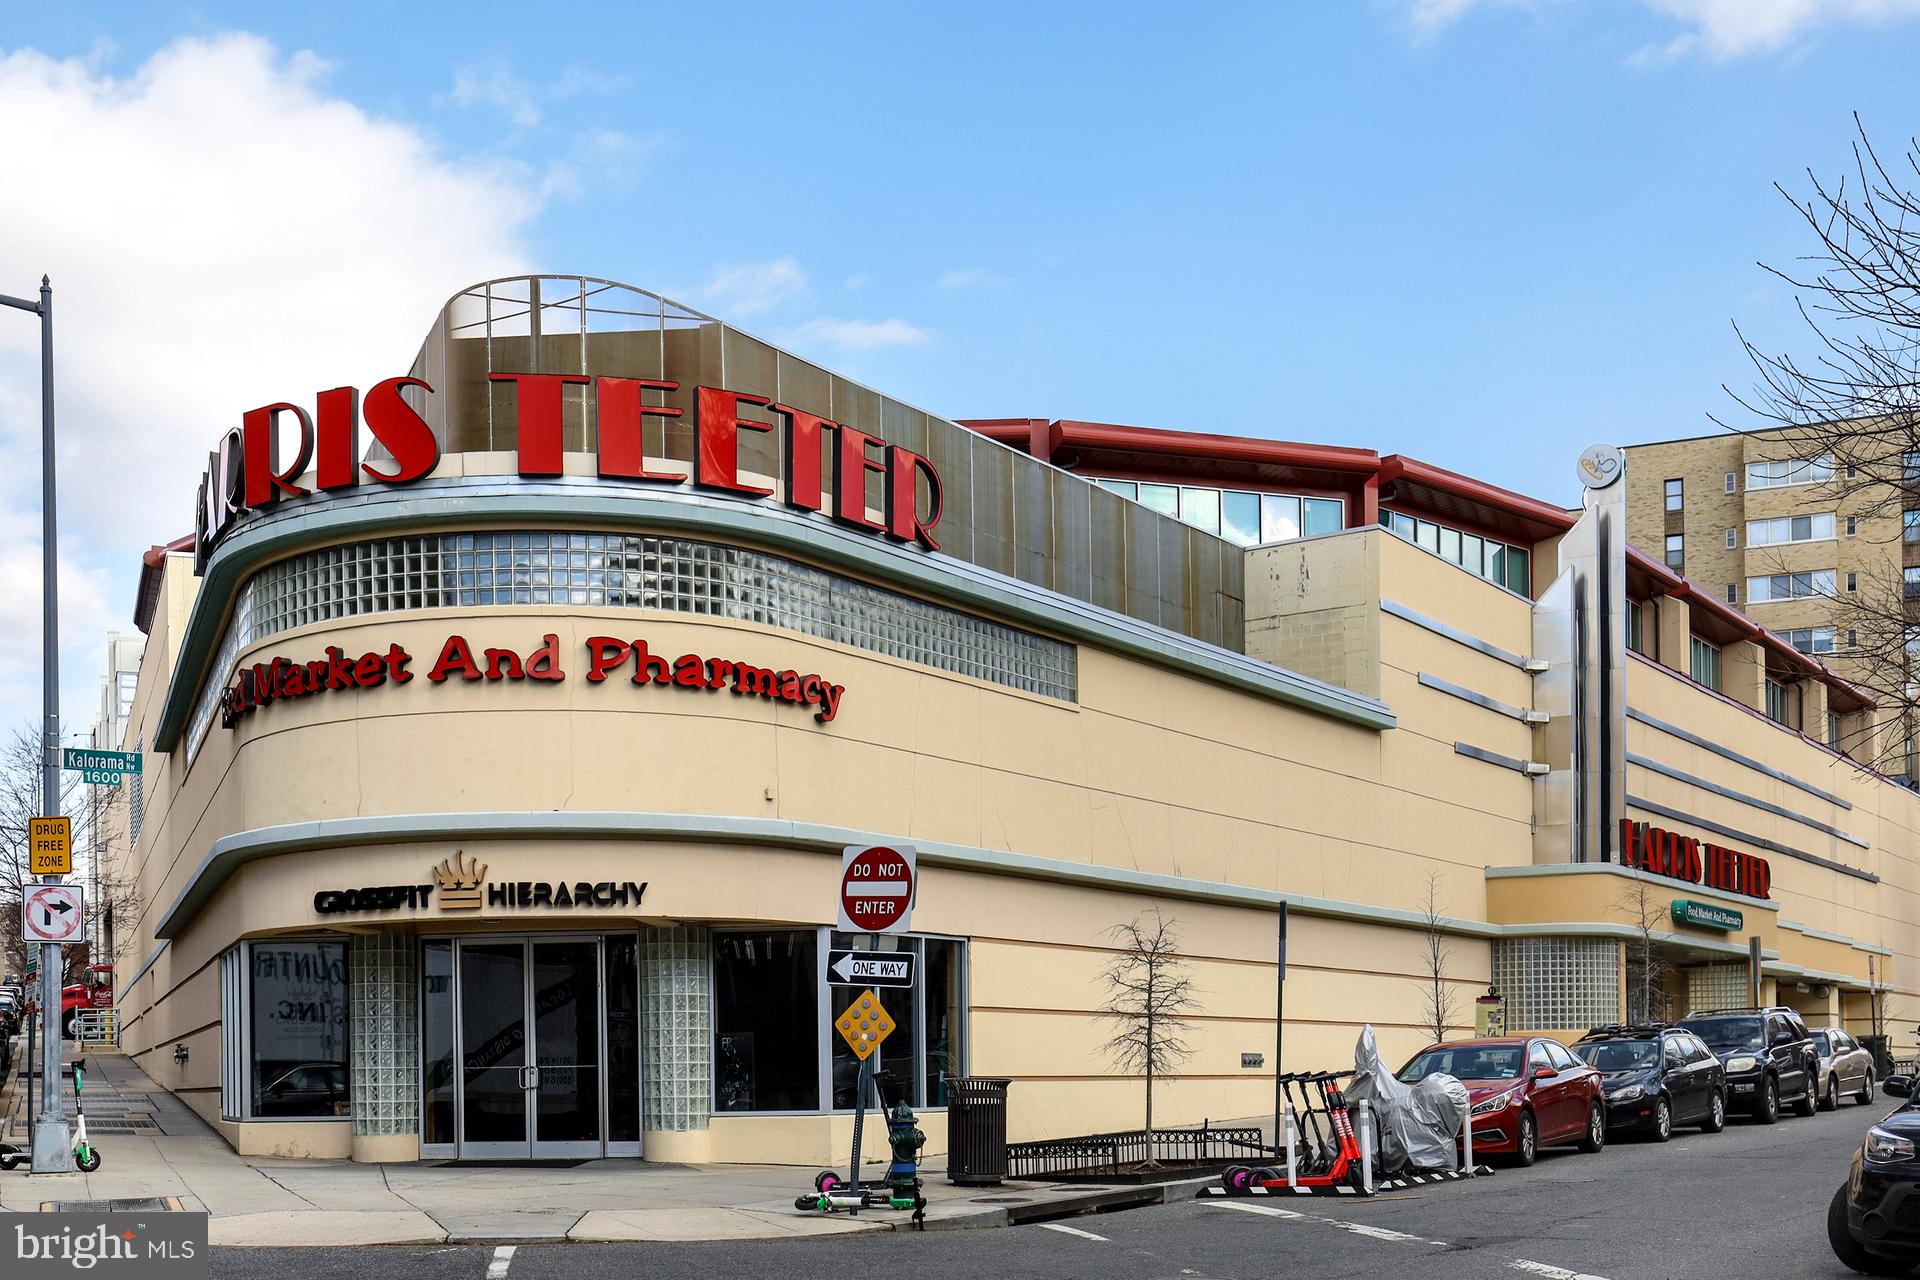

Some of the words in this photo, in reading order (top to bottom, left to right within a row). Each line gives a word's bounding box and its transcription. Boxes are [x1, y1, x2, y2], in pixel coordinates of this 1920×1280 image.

[194, 376, 441, 577] ARRIS
[488, 372, 944, 552] TEETER
[253, 642, 414, 705] Market
[427, 633, 566, 683] And
[586, 635, 846, 723] Pharmacy
[68, 751, 124, 770] Kalorama
[126, 753, 135, 762] Rd
[85, 770, 120, 784] 1600
[35, 824, 65, 836] DRUG
[37, 840, 63, 851] FREE
[38, 855, 63, 867] ZONE
[1619, 818, 1702, 884] HARRIS
[1701, 843, 1771, 900] TEETER
[853, 863, 871, 877] DO
[878, 863, 904, 877] NOT
[487, 881, 649, 908] HIERARCHY
[855, 901, 895, 915] ENTER
[1687, 904, 1698, 918] Food
[1698, 907, 1713, 921] Market
[1713, 910, 1722, 923] And
[1721, 912, 1742, 929] Pharmacy
[853, 962, 876, 975] ONE
[881, 963, 904, 977] WAY
